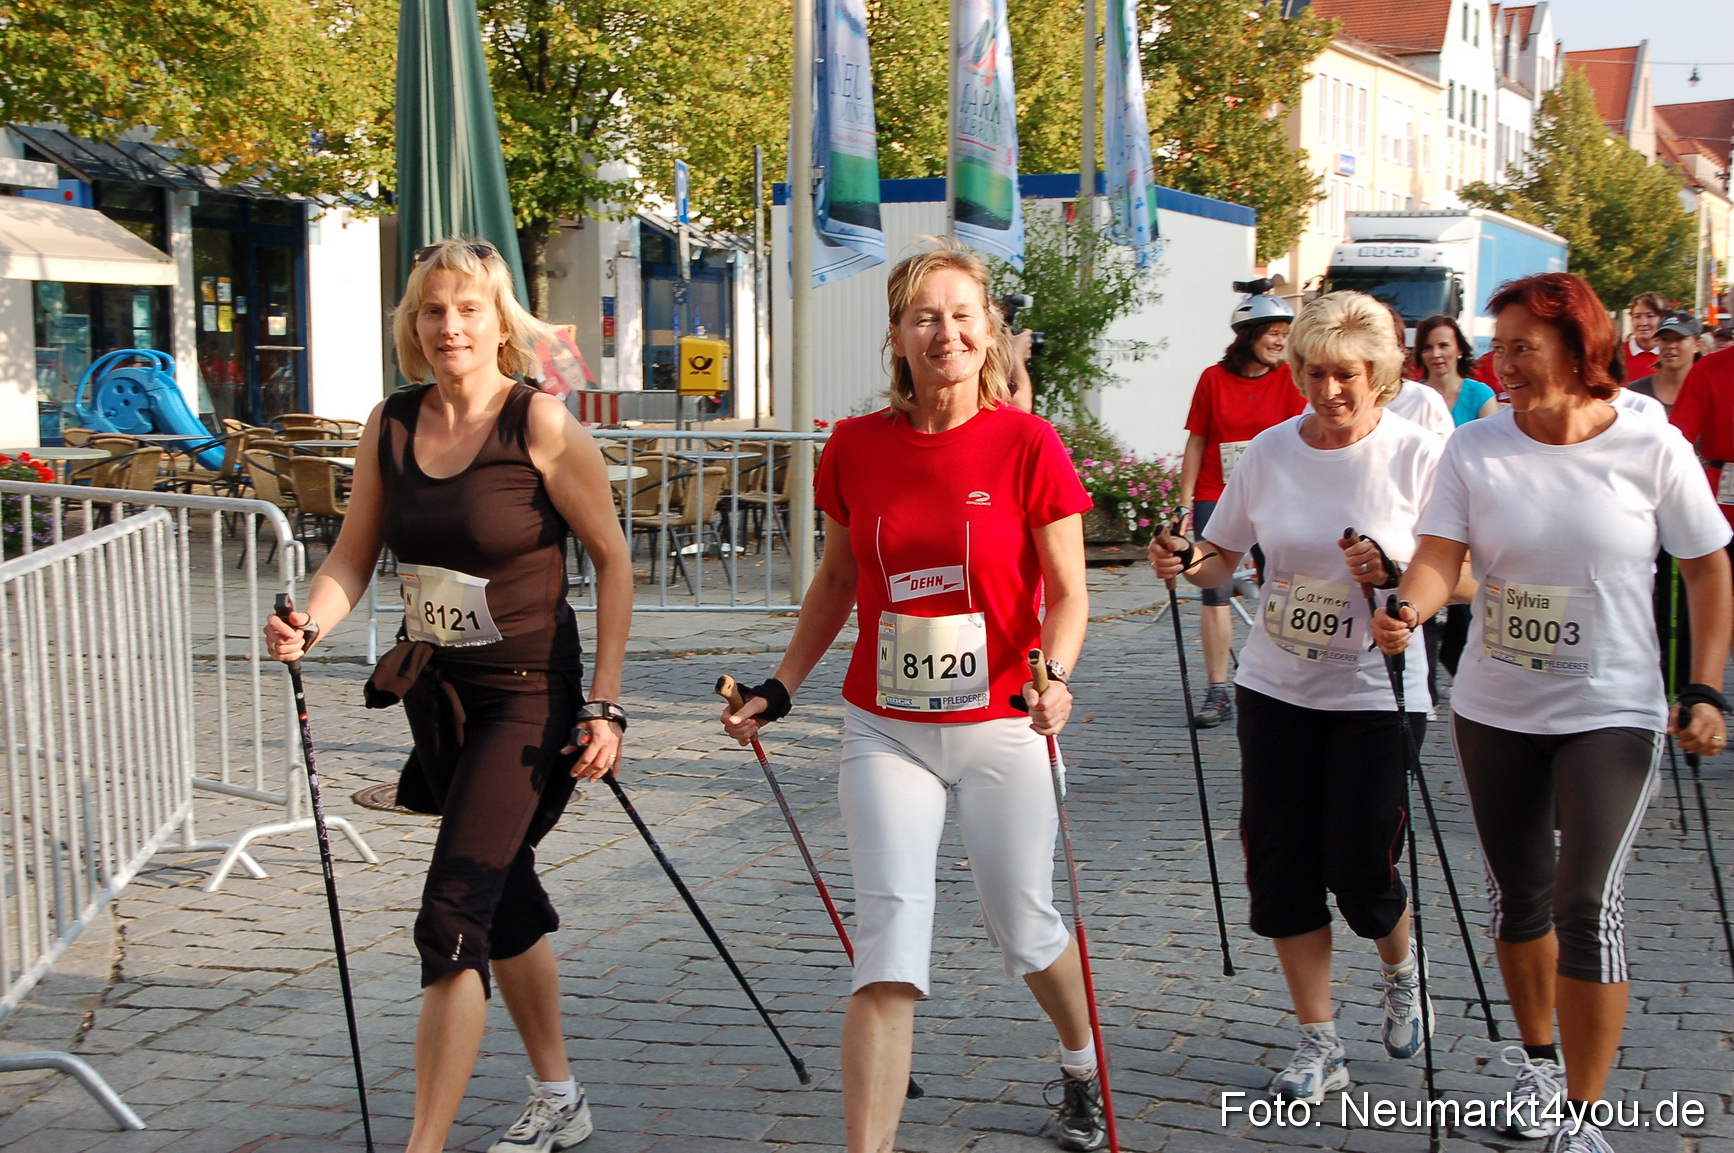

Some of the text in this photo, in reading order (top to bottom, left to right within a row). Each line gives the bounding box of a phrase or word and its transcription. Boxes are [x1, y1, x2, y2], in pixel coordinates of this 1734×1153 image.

[1359, 246, 1419, 258] BOCK
[606, 259, 614, 280] 3
[910, 574, 944, 592] DEHN
[1294, 585, 1351, 609] Carmen
[1507, 588, 1550, 610] Sylvia
[424, 601, 480, 631] 8121
[1290, 607, 1355, 639] 8091
[1508, 615, 1581, 646] 8003
[881, 647, 888, 661] N
[902, 651, 977, 680] 8120
[942, 692, 988, 705] PFLEIDERER
